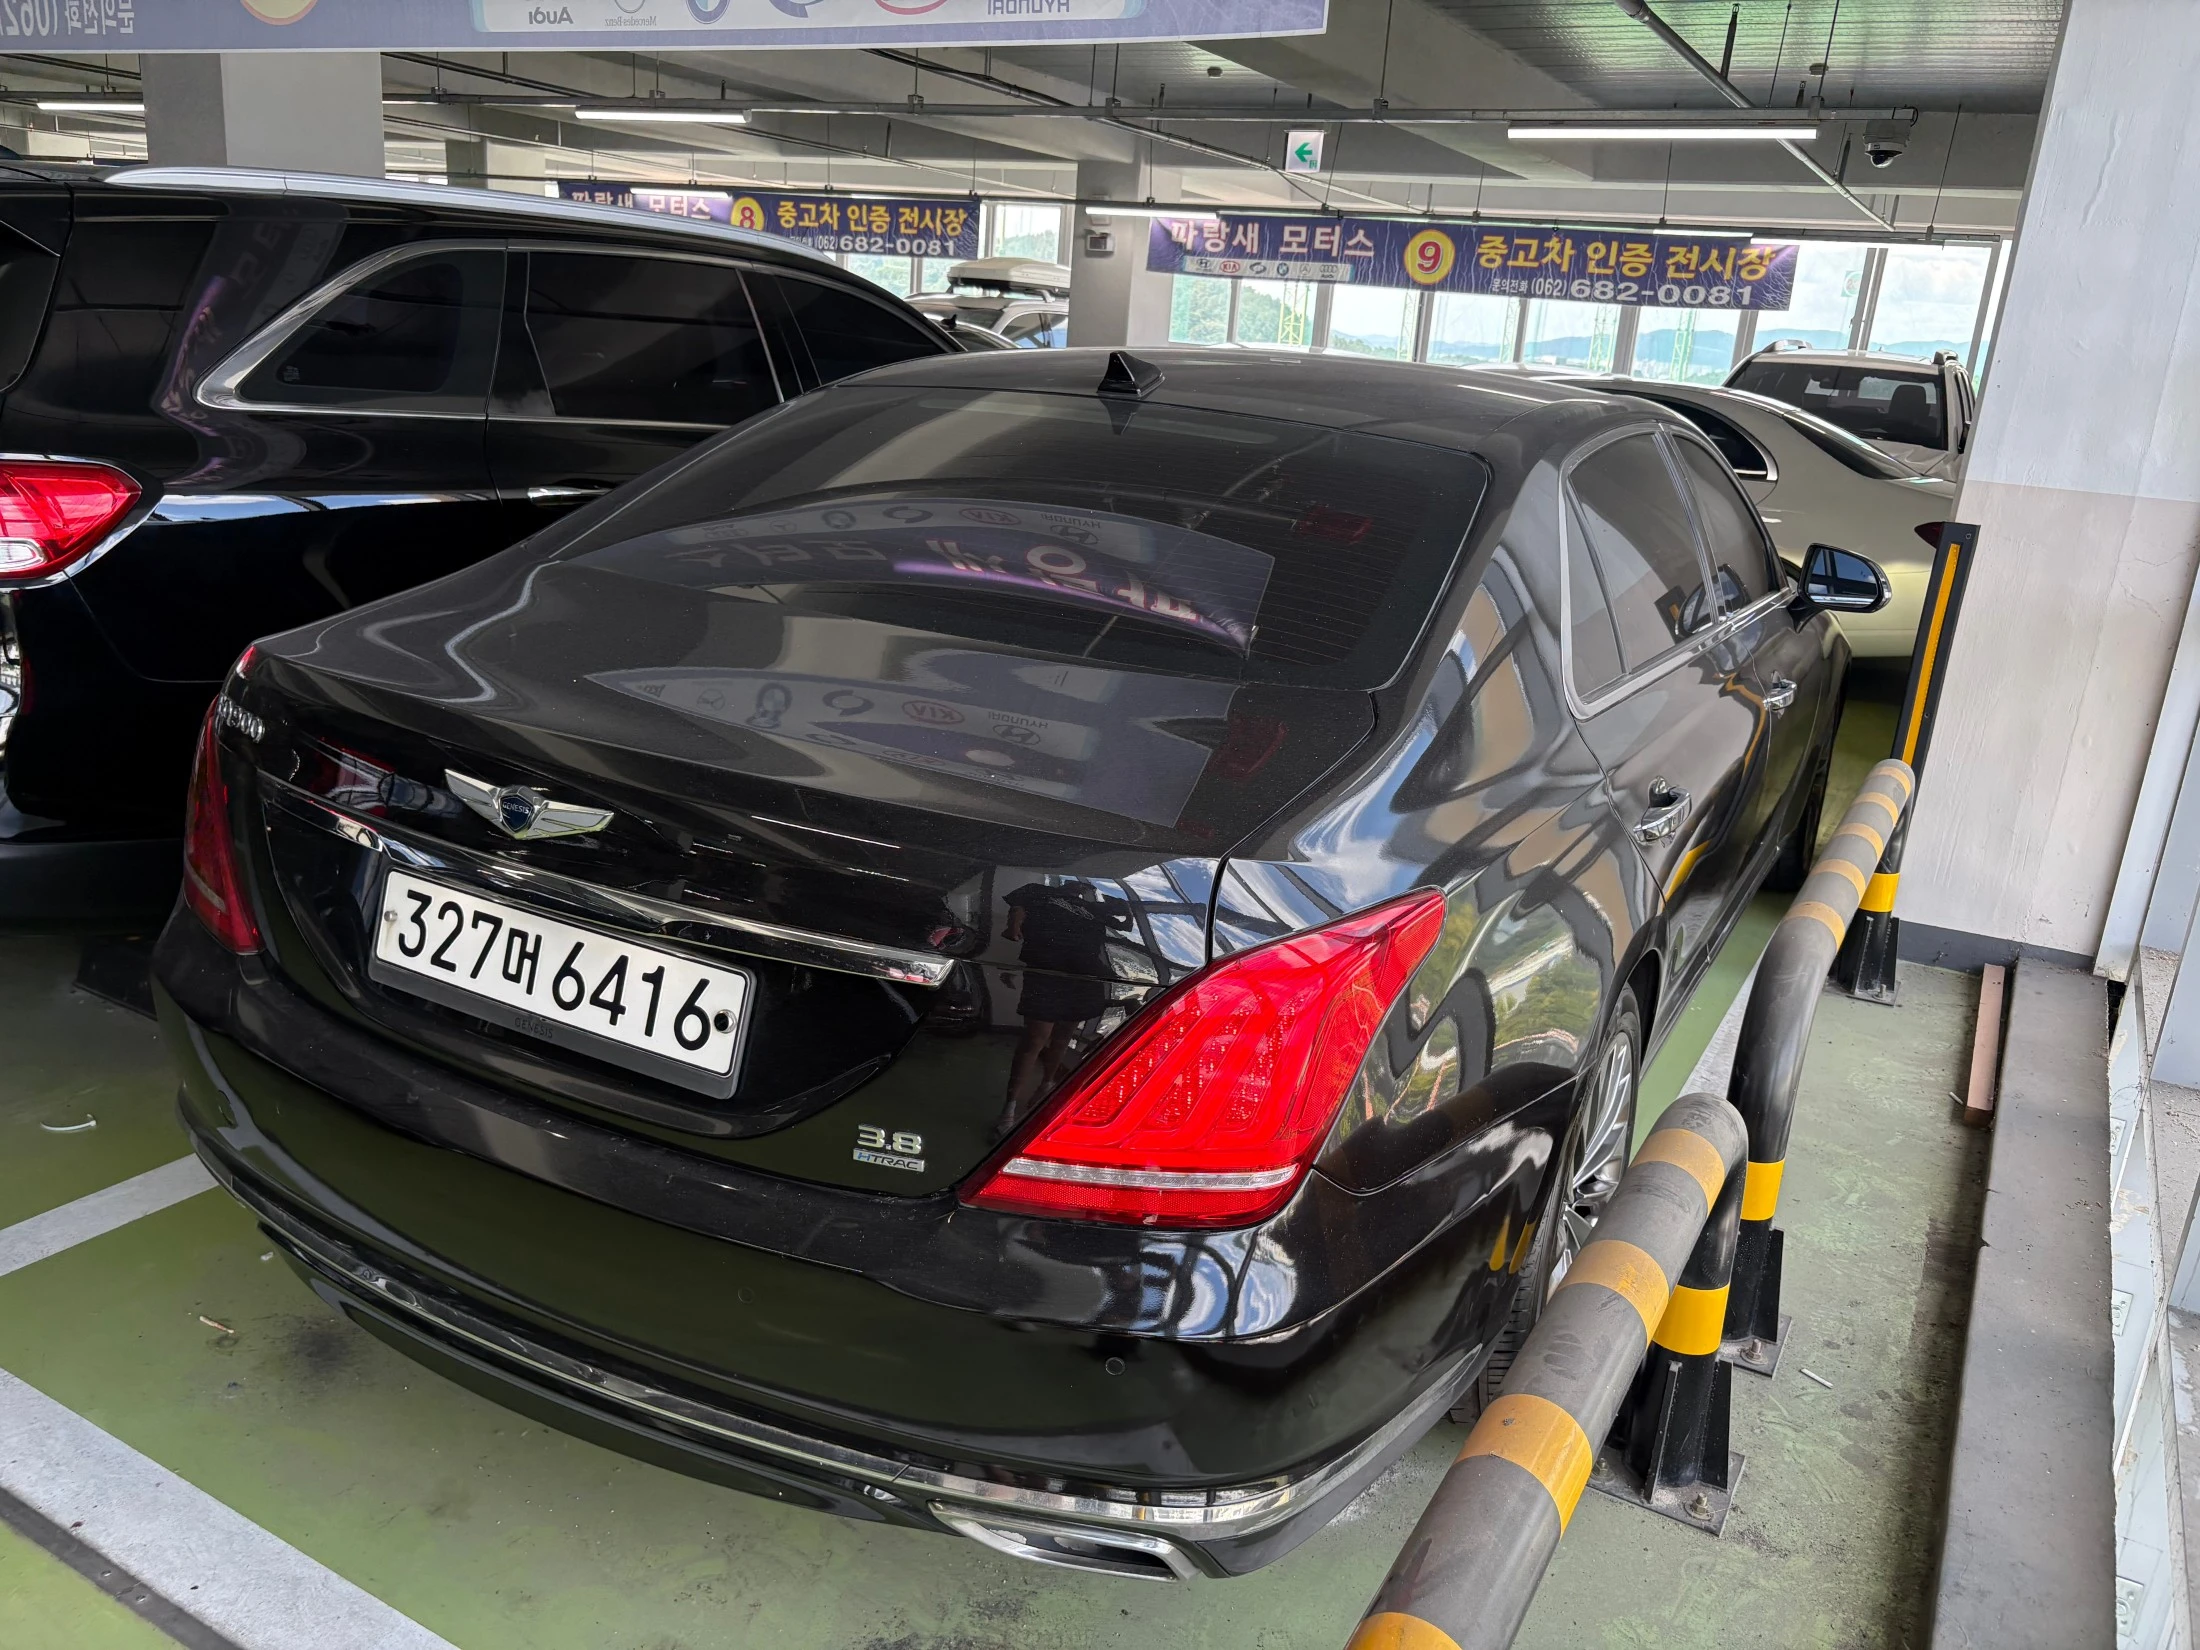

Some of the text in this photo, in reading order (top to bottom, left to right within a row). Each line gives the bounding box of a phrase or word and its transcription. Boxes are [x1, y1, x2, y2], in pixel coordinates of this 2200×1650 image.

[740, 206, 755, 229] 8
[777, 201, 968, 237] 중고차 인증 전시장
[840, 235, 955, 256] 682-0081
[1171, 220, 1375, 257] 파랑새 모터스
[1221, 262, 1239, 272] KIA
[1418, 241, 1443, 273] 9
[1477, 234, 1775, 281] 중고차 인증 전시장
[1492, 278, 1752, 306] 문의전화 (062) 682-0081
[502, 801, 530, 815] GENESIS
[398, 889, 711, 1051] 327머 6416
[514, 1017, 553, 1039] GENESIS
[857, 1123, 922, 1155] 3.8
[857, 1151, 919, 1170] HTRAC
